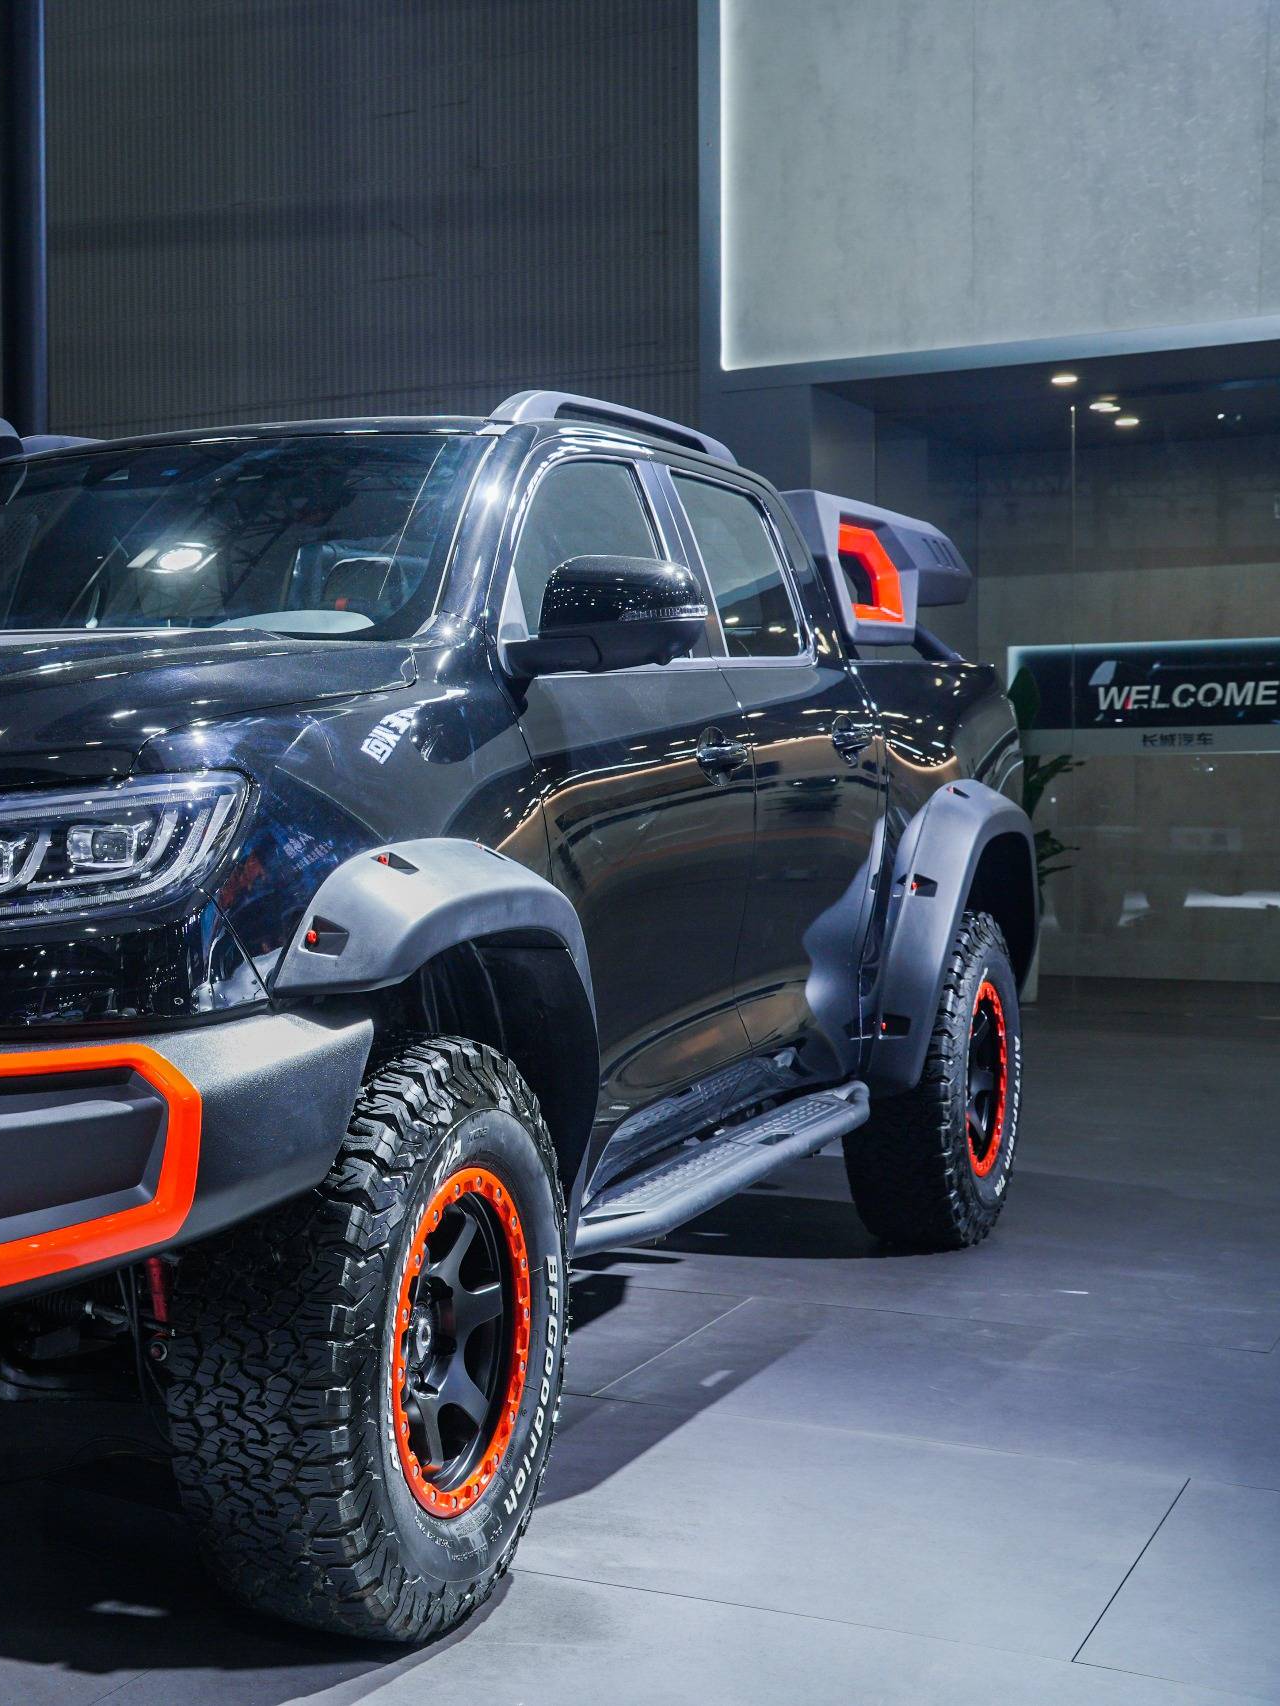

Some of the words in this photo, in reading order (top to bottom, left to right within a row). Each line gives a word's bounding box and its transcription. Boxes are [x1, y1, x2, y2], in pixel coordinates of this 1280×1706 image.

[1098, 680, 1280, 710] WELCOME
[1142, 732, 1214, 748] 长城汽车
[503, 1255, 560, 1515] BFGoodrich
